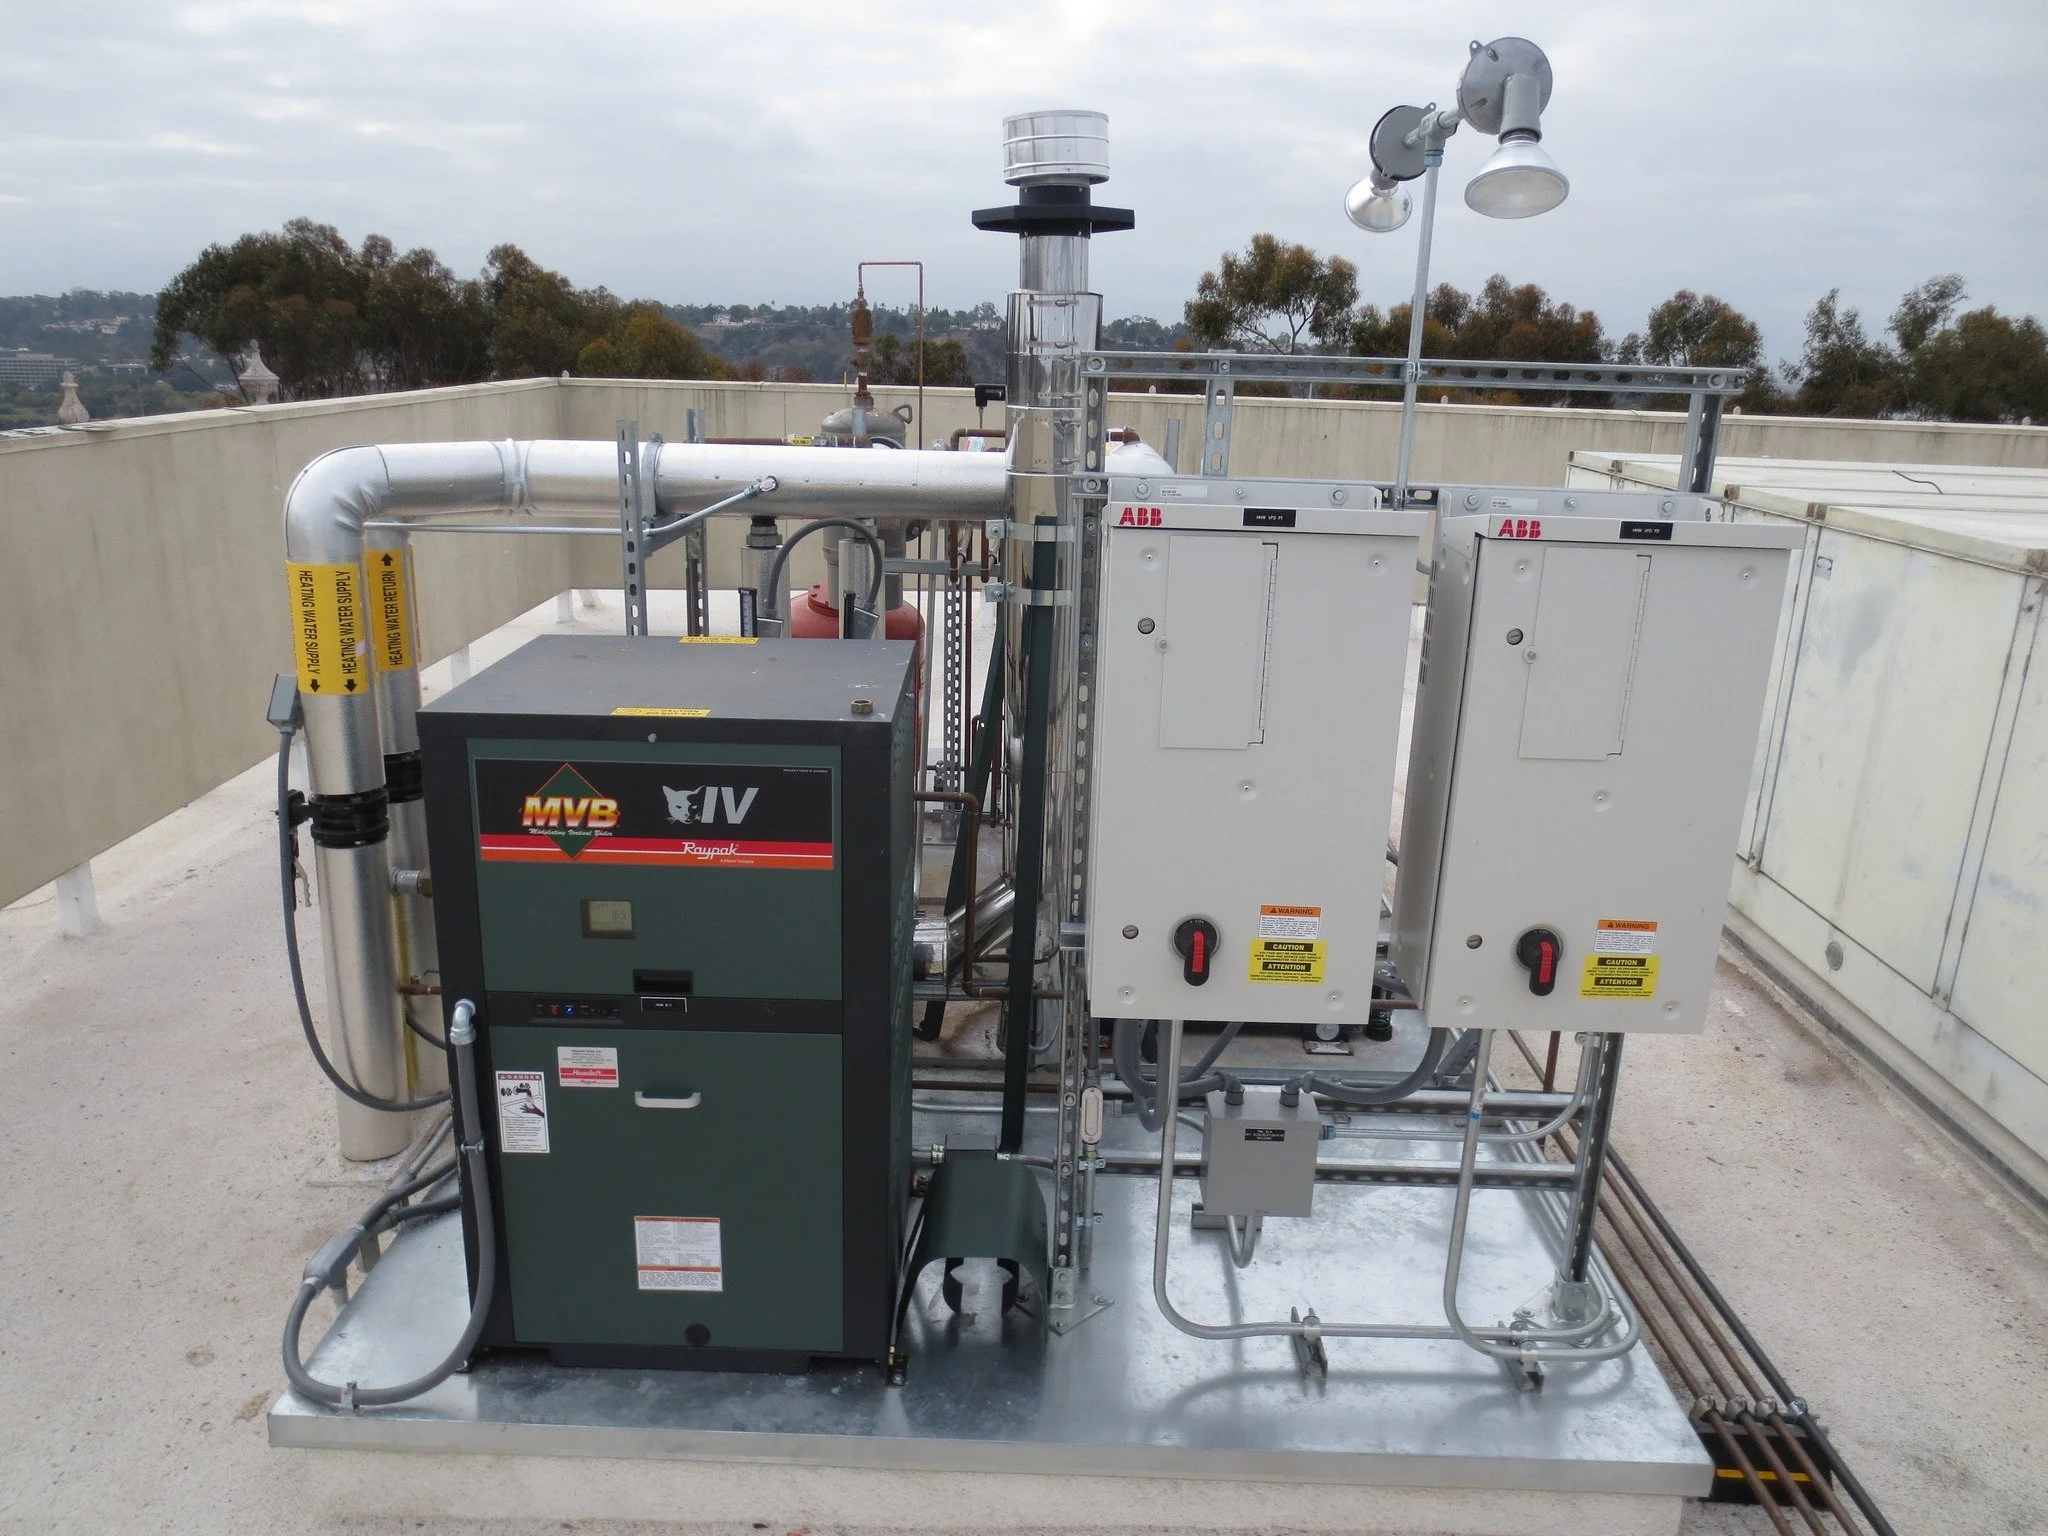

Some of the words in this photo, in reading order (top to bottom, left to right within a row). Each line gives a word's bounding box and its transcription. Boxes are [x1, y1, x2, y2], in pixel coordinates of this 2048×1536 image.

[1119, 507, 1163, 526] ABB
[1498, 519, 1542, 538] ABB
[299, 570, 315, 608] HEATING
[335, 570, 353, 604] SUPPLY
[381, 570, 398, 602] RETURN
[303, 609, 318, 640] WATER
[338, 605, 355, 636] WATER
[384, 603, 400, 632] WATER
[305, 641, 320, 675] SUPPLY
[340, 637, 357, 674] HEATING
[387, 632, 404, 666] HEATING
[521, 796, 618, 829] MVB
[701, 786, 760, 824] IV
[528, 828, 566, 836] Modulating
[567, 829, 592, 837] Vertical
[594, 829, 613, 837] Boiler
[682, 842, 738, 860] Raypak
[1278, 907, 1314, 915] WARNING
[1615, 922, 1650, 930] WARNING
